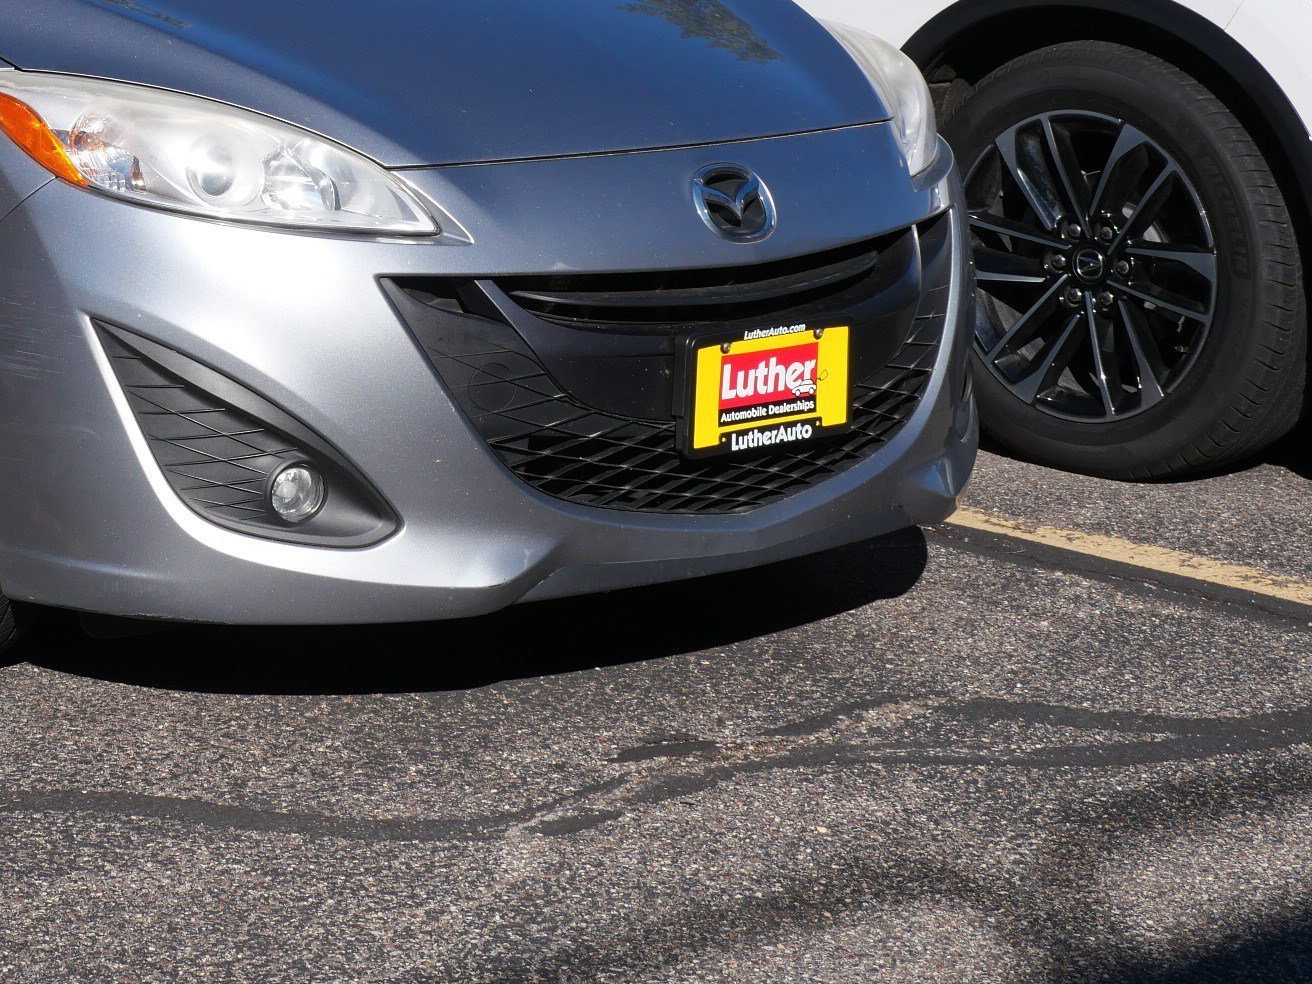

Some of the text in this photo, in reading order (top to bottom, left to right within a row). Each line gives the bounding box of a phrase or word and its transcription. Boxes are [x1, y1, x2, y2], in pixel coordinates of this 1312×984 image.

[743, 324, 806, 340] LutherAuto.com
[721, 356, 816, 400] Luther
[720, 400, 814, 423] Automobile Dealerships
[731, 423, 812, 452] LutherAuto
